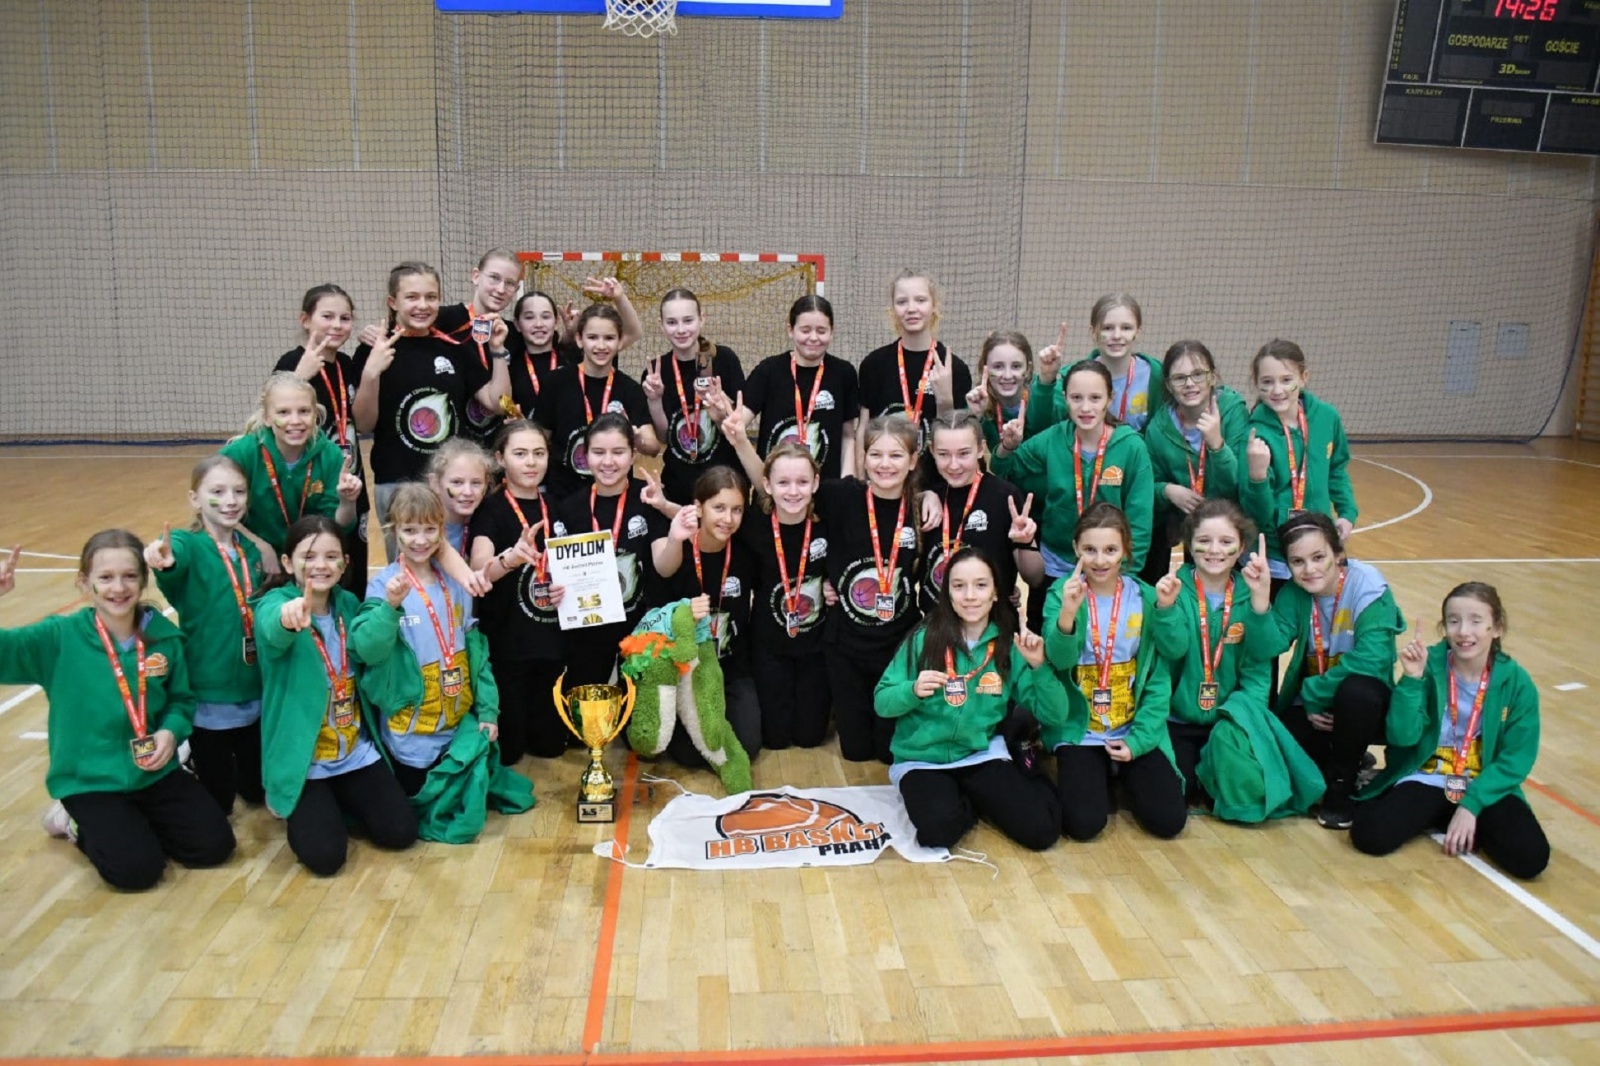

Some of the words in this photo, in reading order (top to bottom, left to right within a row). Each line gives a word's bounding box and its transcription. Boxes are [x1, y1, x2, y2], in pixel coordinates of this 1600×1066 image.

[1494, 0, 1559, 21] 14:26
[1448, 34, 1509, 50] GOSPODARZE
[1545, 38, 1580, 54] GOŚCIE
[556, 538, 606, 561] DYPLOM
[706, 837, 759, 860] HB
[761, 823, 885, 853] BASKET
[819, 832, 892, 856] PRAHA
